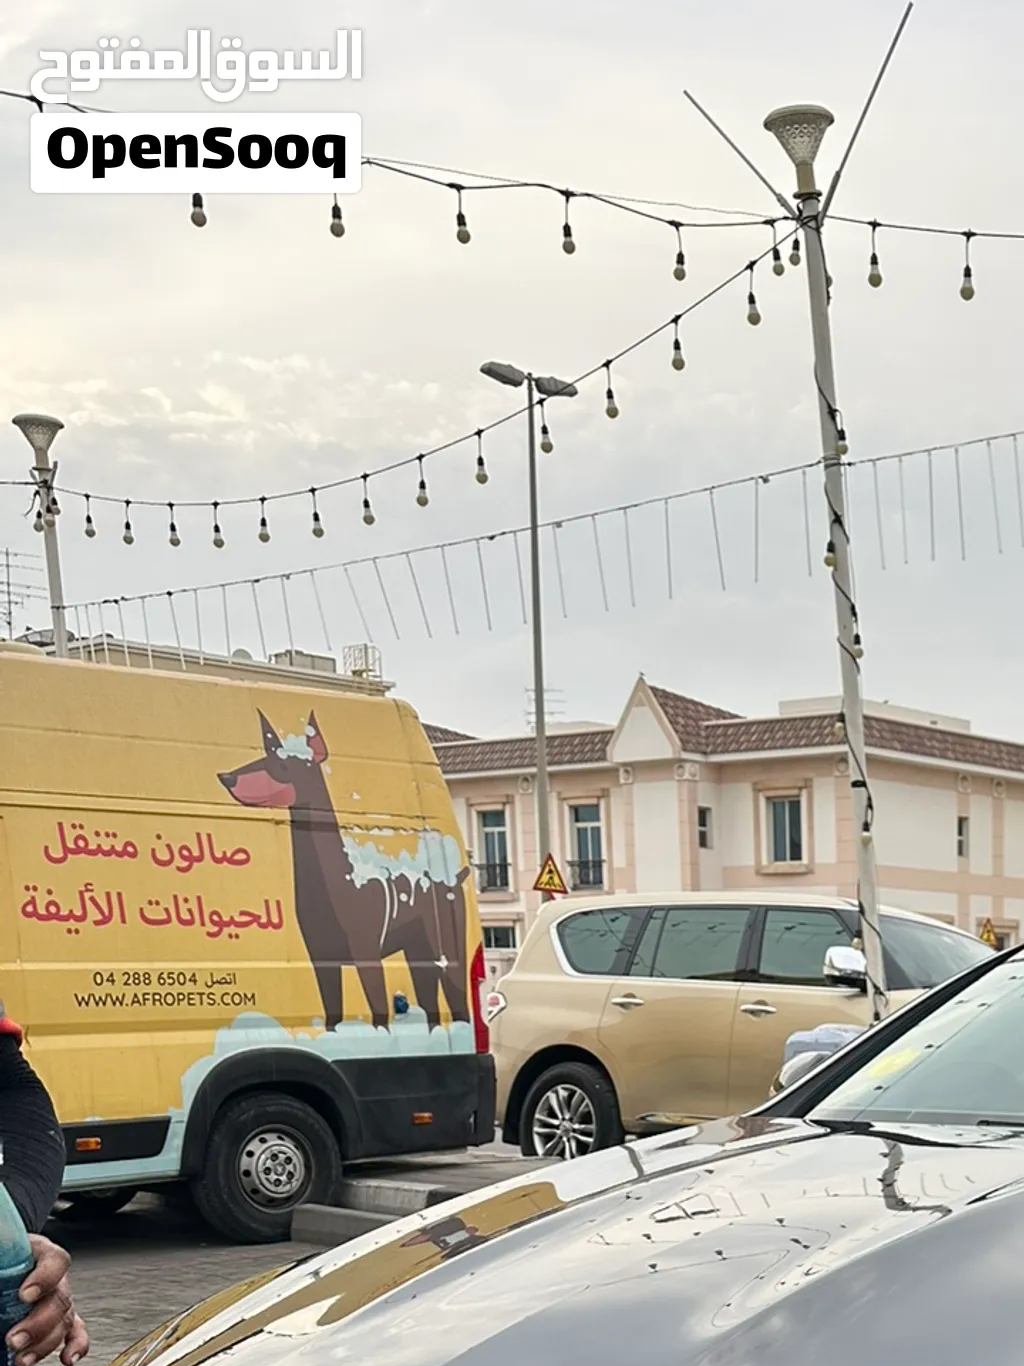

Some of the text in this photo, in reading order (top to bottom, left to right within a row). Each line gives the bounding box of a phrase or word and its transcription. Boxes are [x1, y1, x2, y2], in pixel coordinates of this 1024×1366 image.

[43, 821, 251, 873] صالون متنقل
[20, 882, 284, 940] للحيوانات الأليفة
[93, 971, 237, 988] اتصل 04 288 6504
[74, 991, 257, 1008] WWW.AFROPETS.COM
